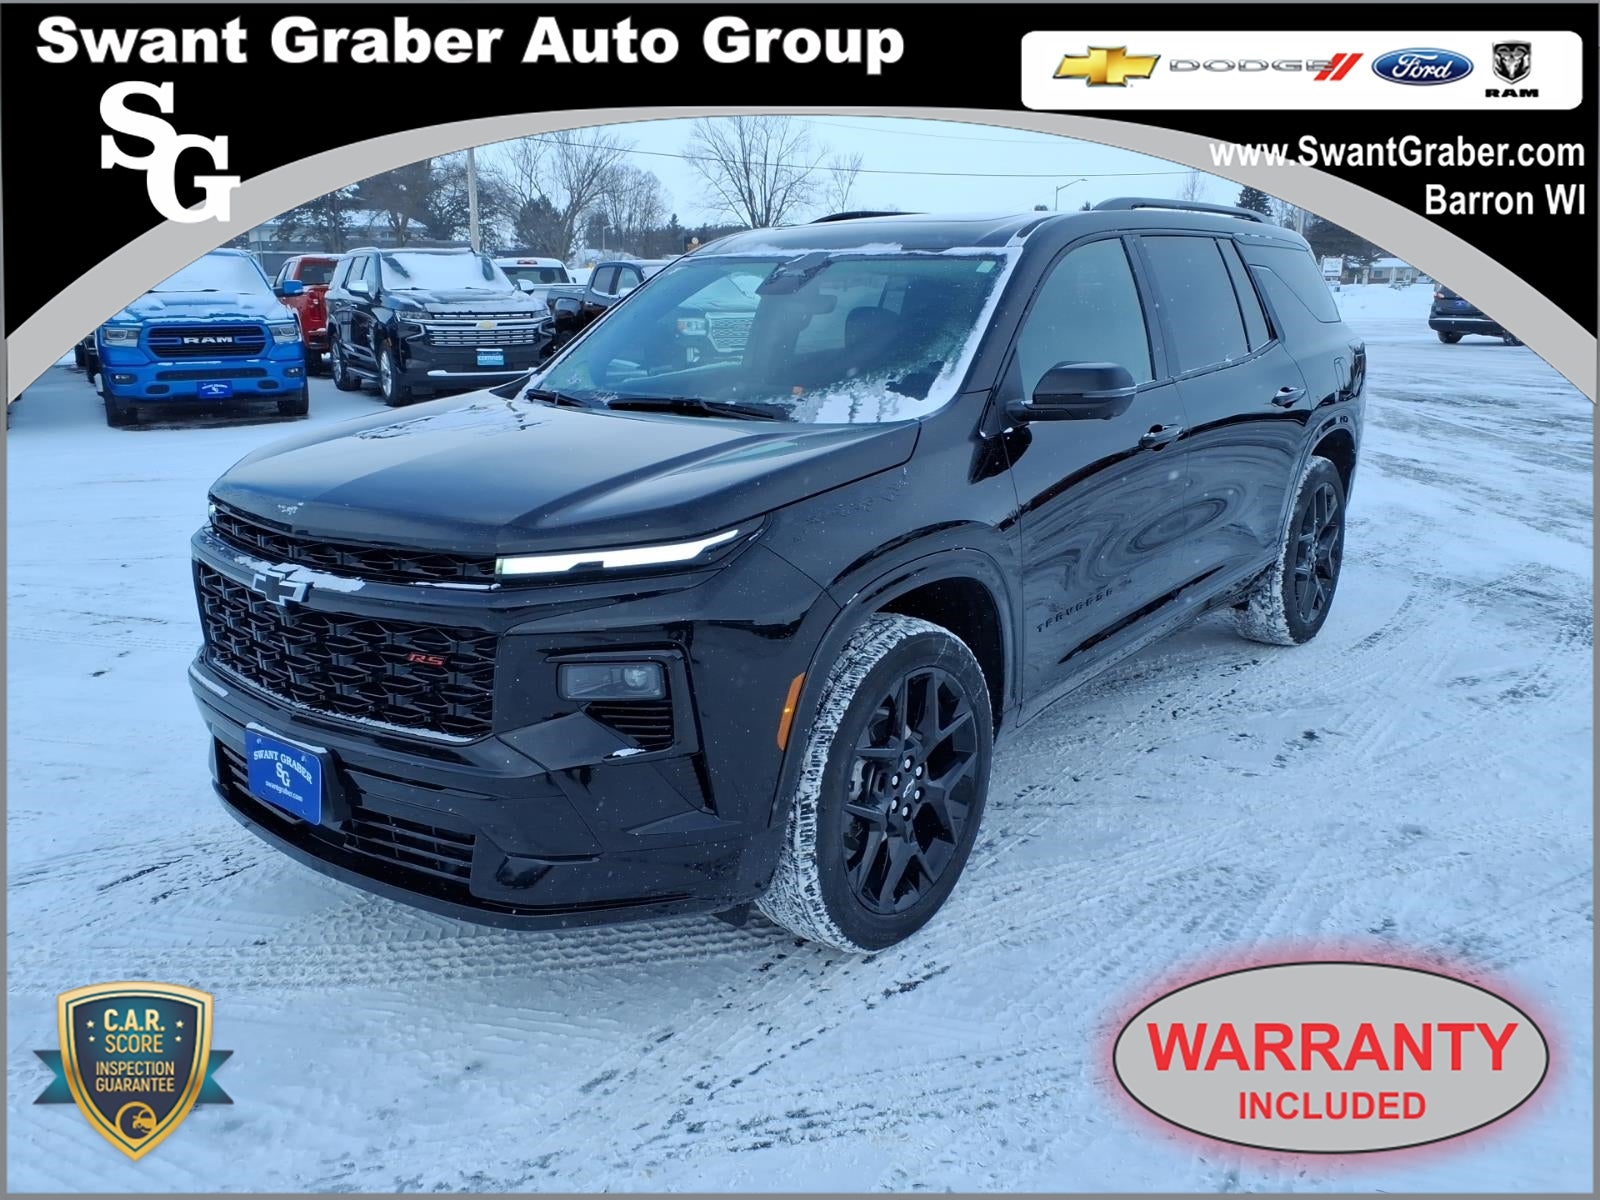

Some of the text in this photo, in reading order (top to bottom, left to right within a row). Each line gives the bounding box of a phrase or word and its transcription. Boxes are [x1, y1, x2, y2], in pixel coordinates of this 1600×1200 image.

[183, 336, 233, 344] RAM
[1036, 588, 1113, 633] TRAVERSE
[409, 653, 445, 666] RS
[253, 749, 313, 785] SWANT GRABER
